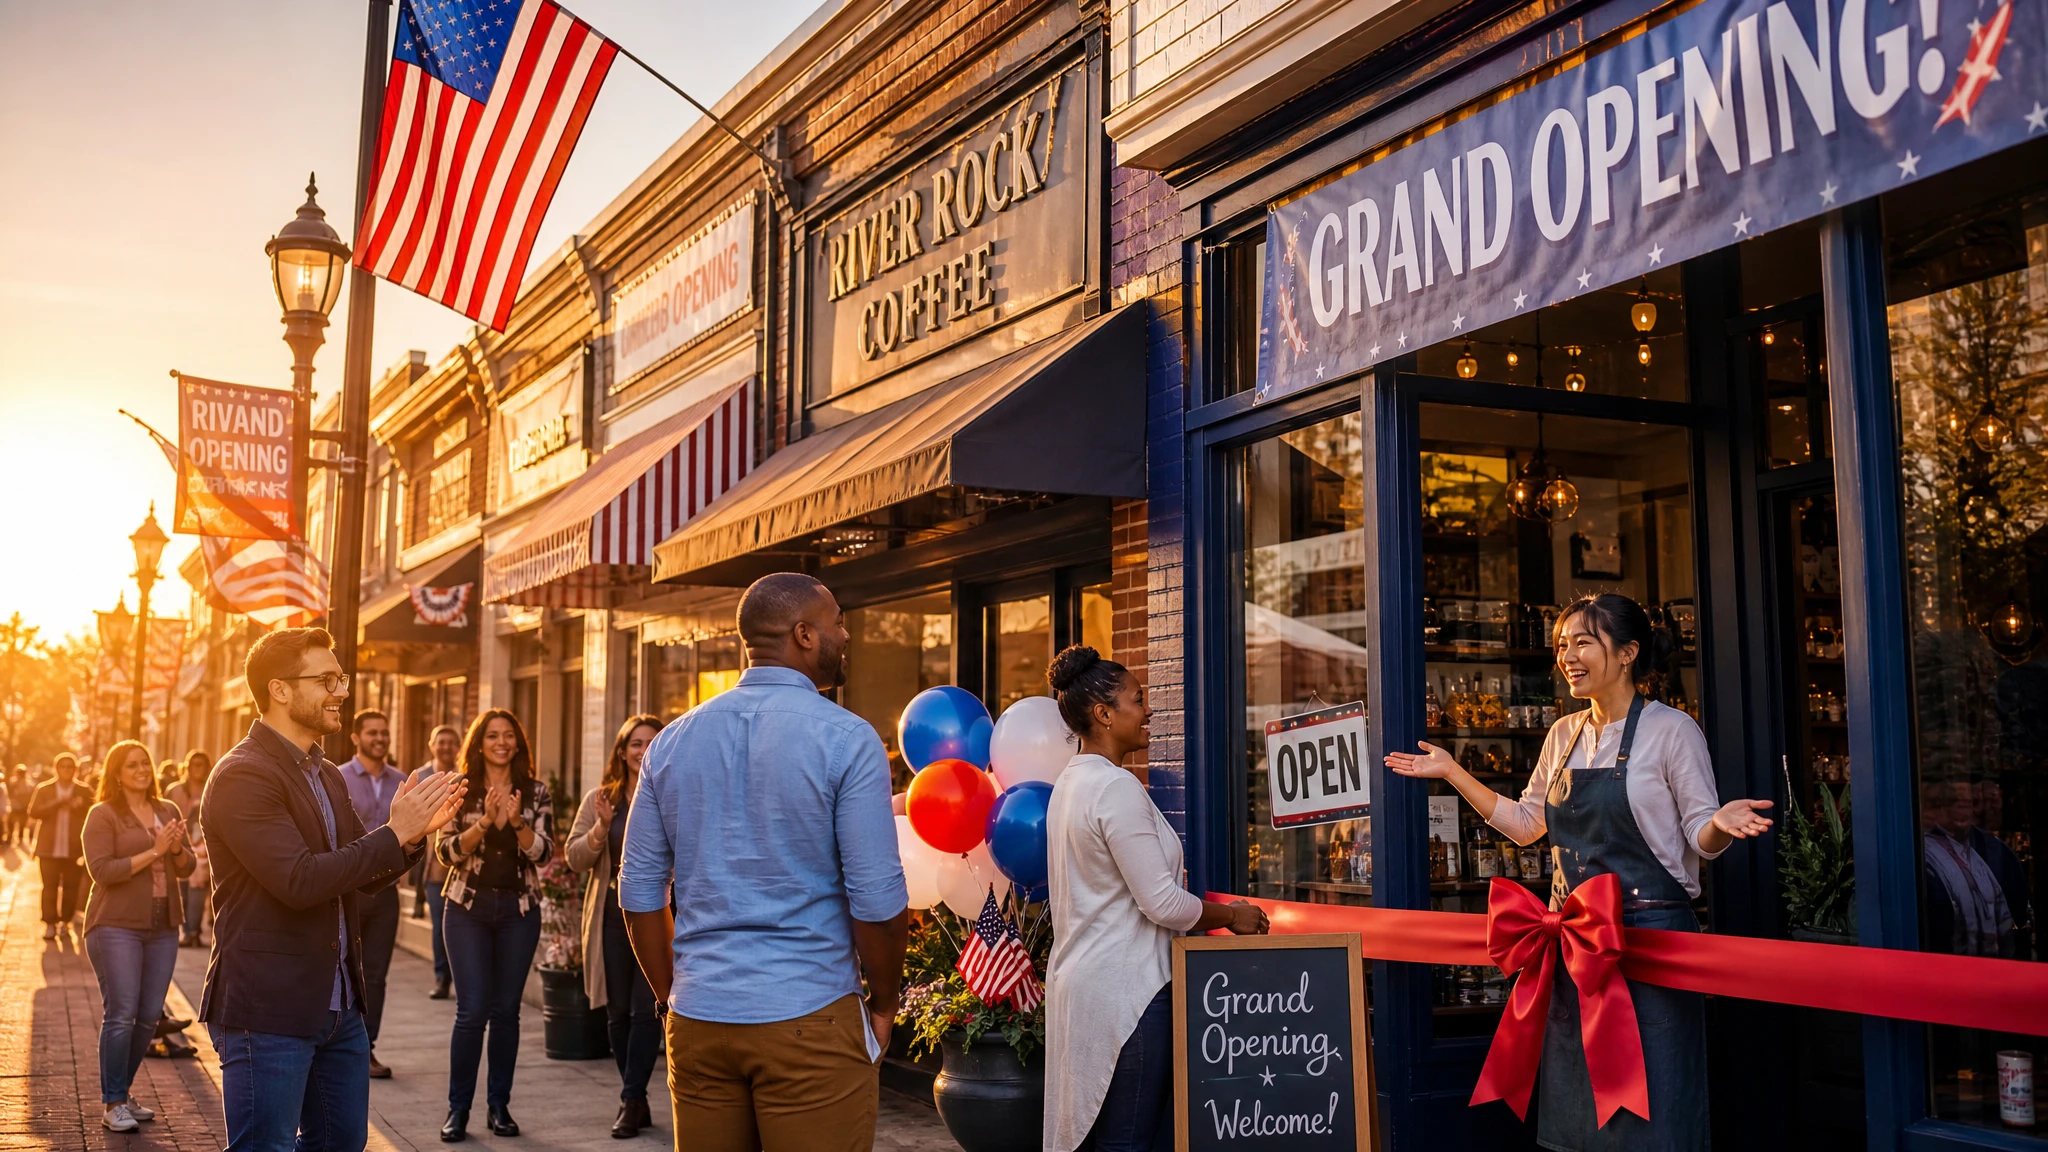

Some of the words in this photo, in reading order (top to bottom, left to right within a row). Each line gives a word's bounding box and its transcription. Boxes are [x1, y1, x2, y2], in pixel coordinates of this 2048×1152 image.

[1309, 142, 1514, 328] GRAND
[1530, 0, 1946, 242] OPENING!
[828, 190, 924, 302] RIVER
[931, 111, 1044, 245] ROCK
[673, 241, 739, 325] OPENING
[858, 241, 995, 362] COFFEE
[192, 399, 284, 438] RIVAND
[189, 437, 287, 475] OPENING
[1277, 731, 1361, 802] OPEN
[1203, 970, 1314, 1023] Grand
[1204, 1091, 1339, 1140] Welcome!
